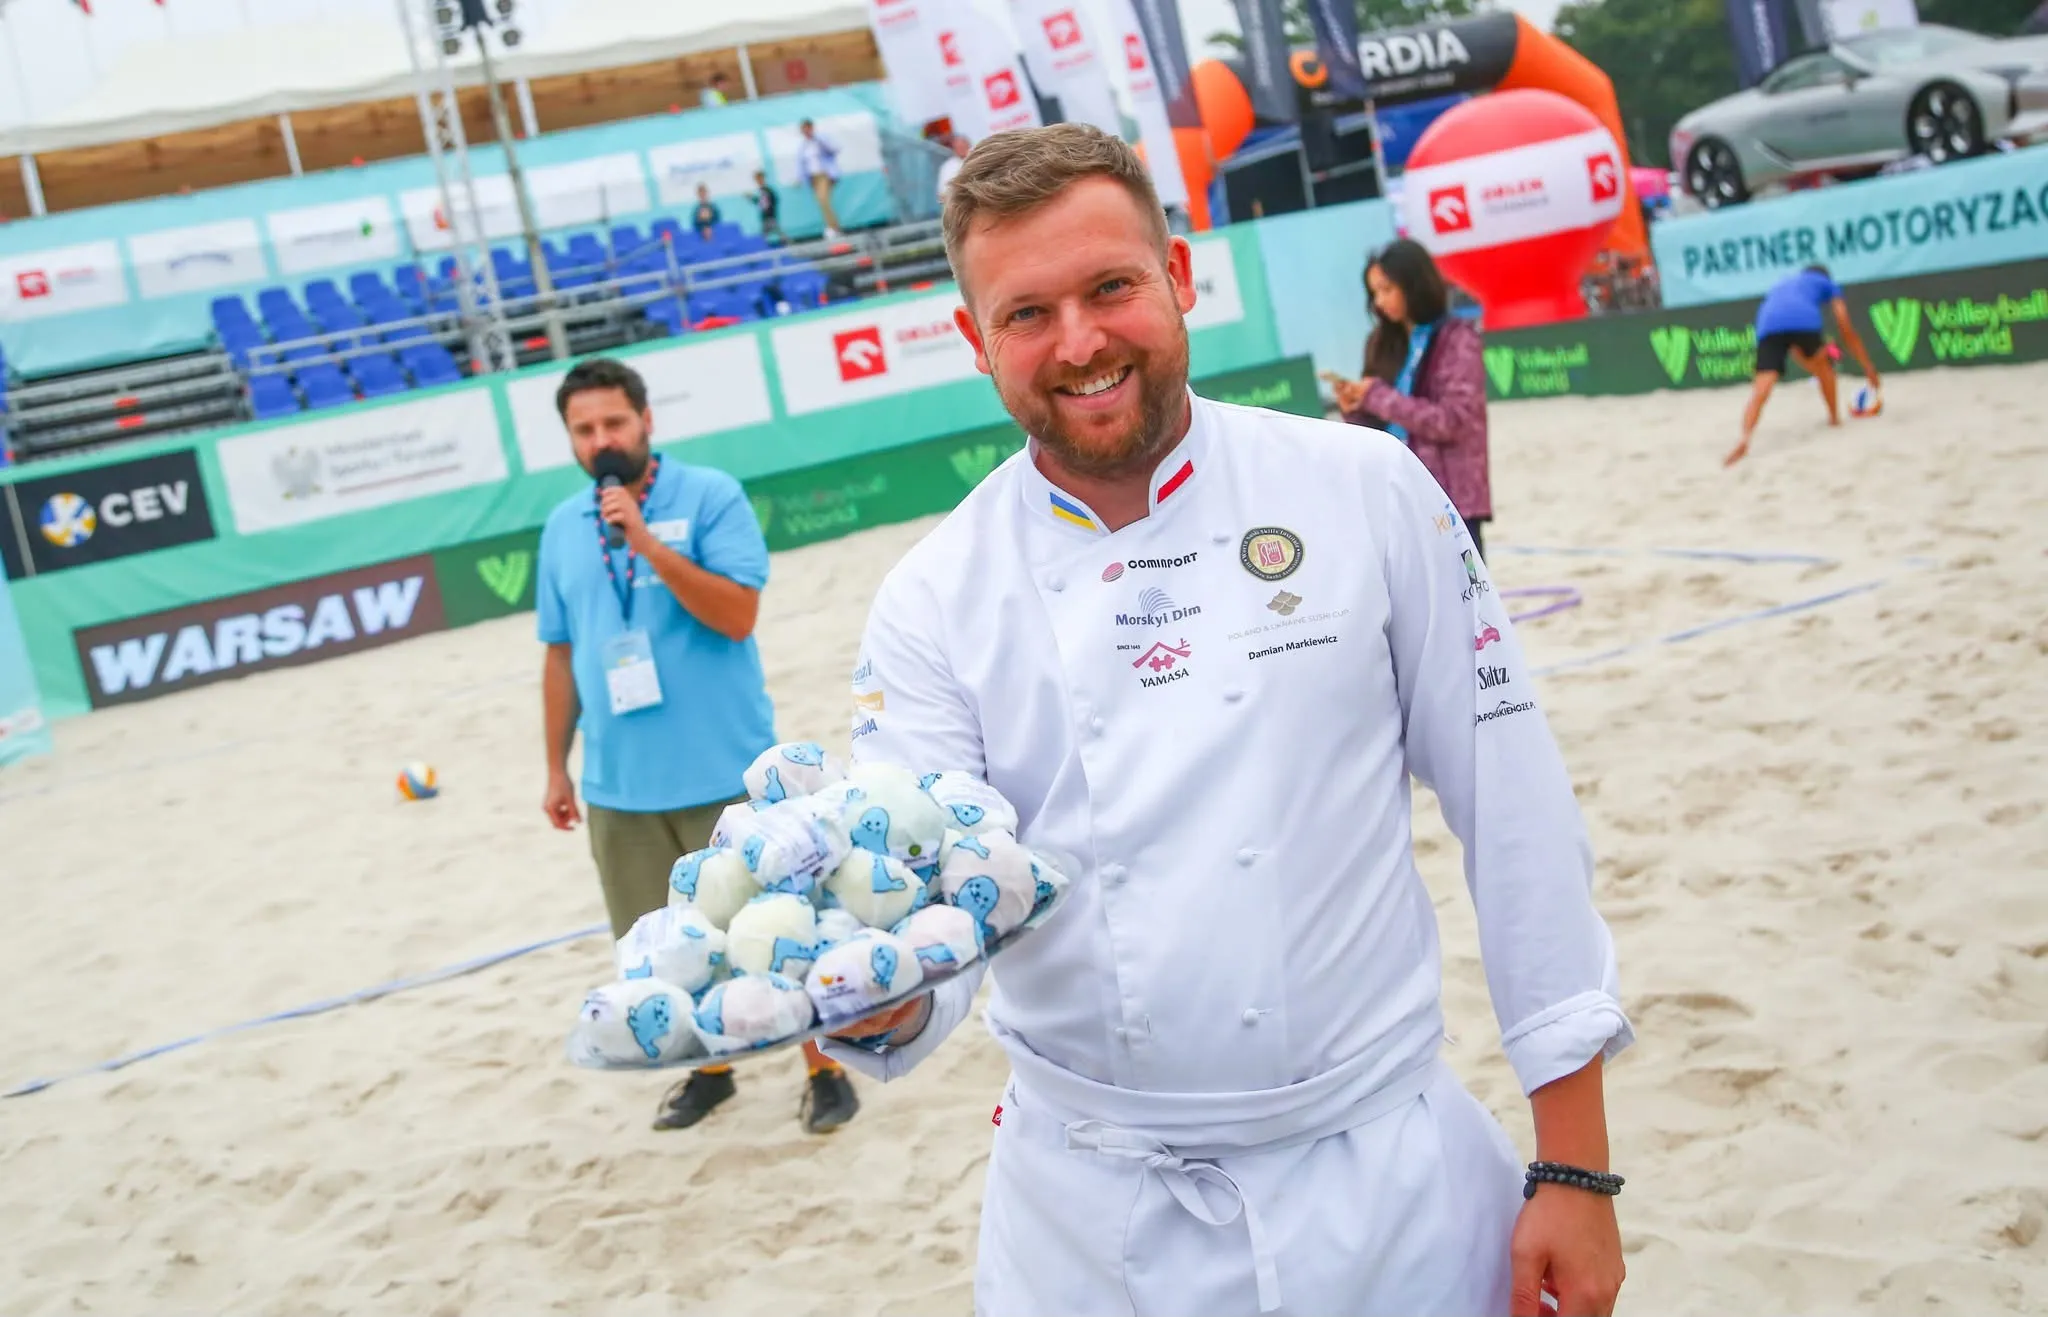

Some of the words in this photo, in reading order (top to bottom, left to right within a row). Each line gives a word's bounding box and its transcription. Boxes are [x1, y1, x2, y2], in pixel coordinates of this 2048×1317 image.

[1683, 226, 1817, 278] PARTNER
[1925, 289, 2048, 330] Volleyball
[1930, 324, 2014, 360] World
[100, 481, 188, 527] CEV
[1128, 552, 1198, 569] COMINPORT
[1115, 613, 1169, 628] Morskyi
[1172, 605, 1201, 621] Dim
[1228, 627, 1262, 641] POLAND
[1308, 612, 1331, 623] SUSHI
[1332, 608, 1350, 619] CUP
[91, 576, 424, 695] WARSAW
[1248, 645, 1284, 660] Damian
[1285, 635, 1338, 651] Markiewicz
[1140, 667, 1190, 688] YAMASA
